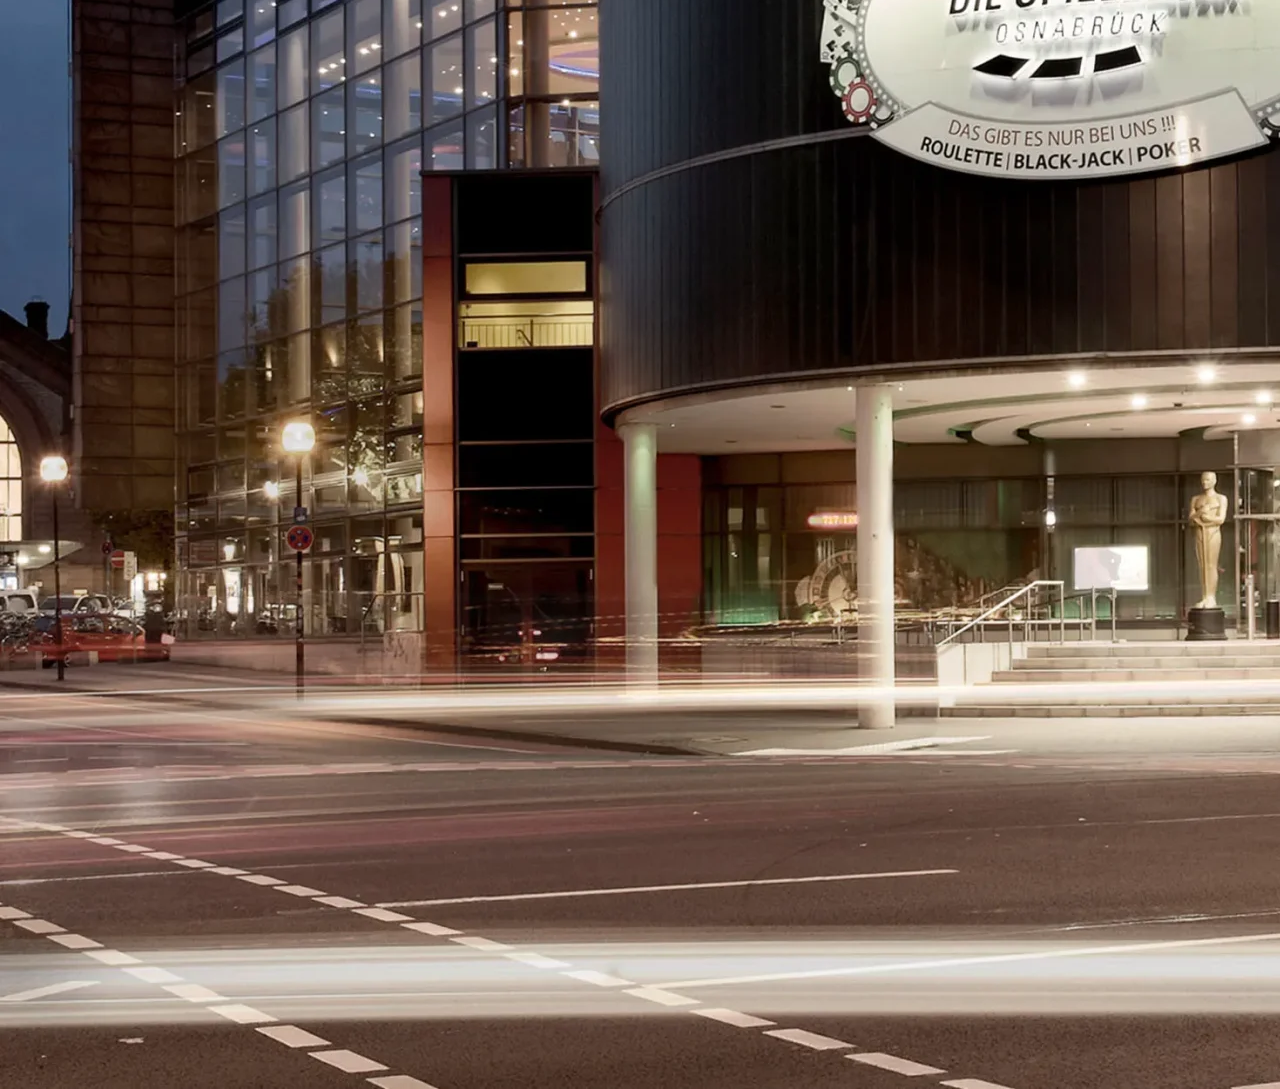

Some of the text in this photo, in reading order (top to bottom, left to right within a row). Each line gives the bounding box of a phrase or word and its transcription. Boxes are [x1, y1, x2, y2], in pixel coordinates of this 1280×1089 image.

[996, 12, 1168, 43] OSNABRÜCK
[948, 119, 981, 141] DAS
[984, 127, 1019, 146] GIBT
[1024, 130, 1044, 147] ES
[1048, 129, 1085, 146] NUR
[1089, 123, 1116, 143] BEI
[1119, 118, 1158, 140] UNS
[920, 136, 1004, 168] ROULETTE
[1013, 148, 1125, 170] BLACK-JACK
